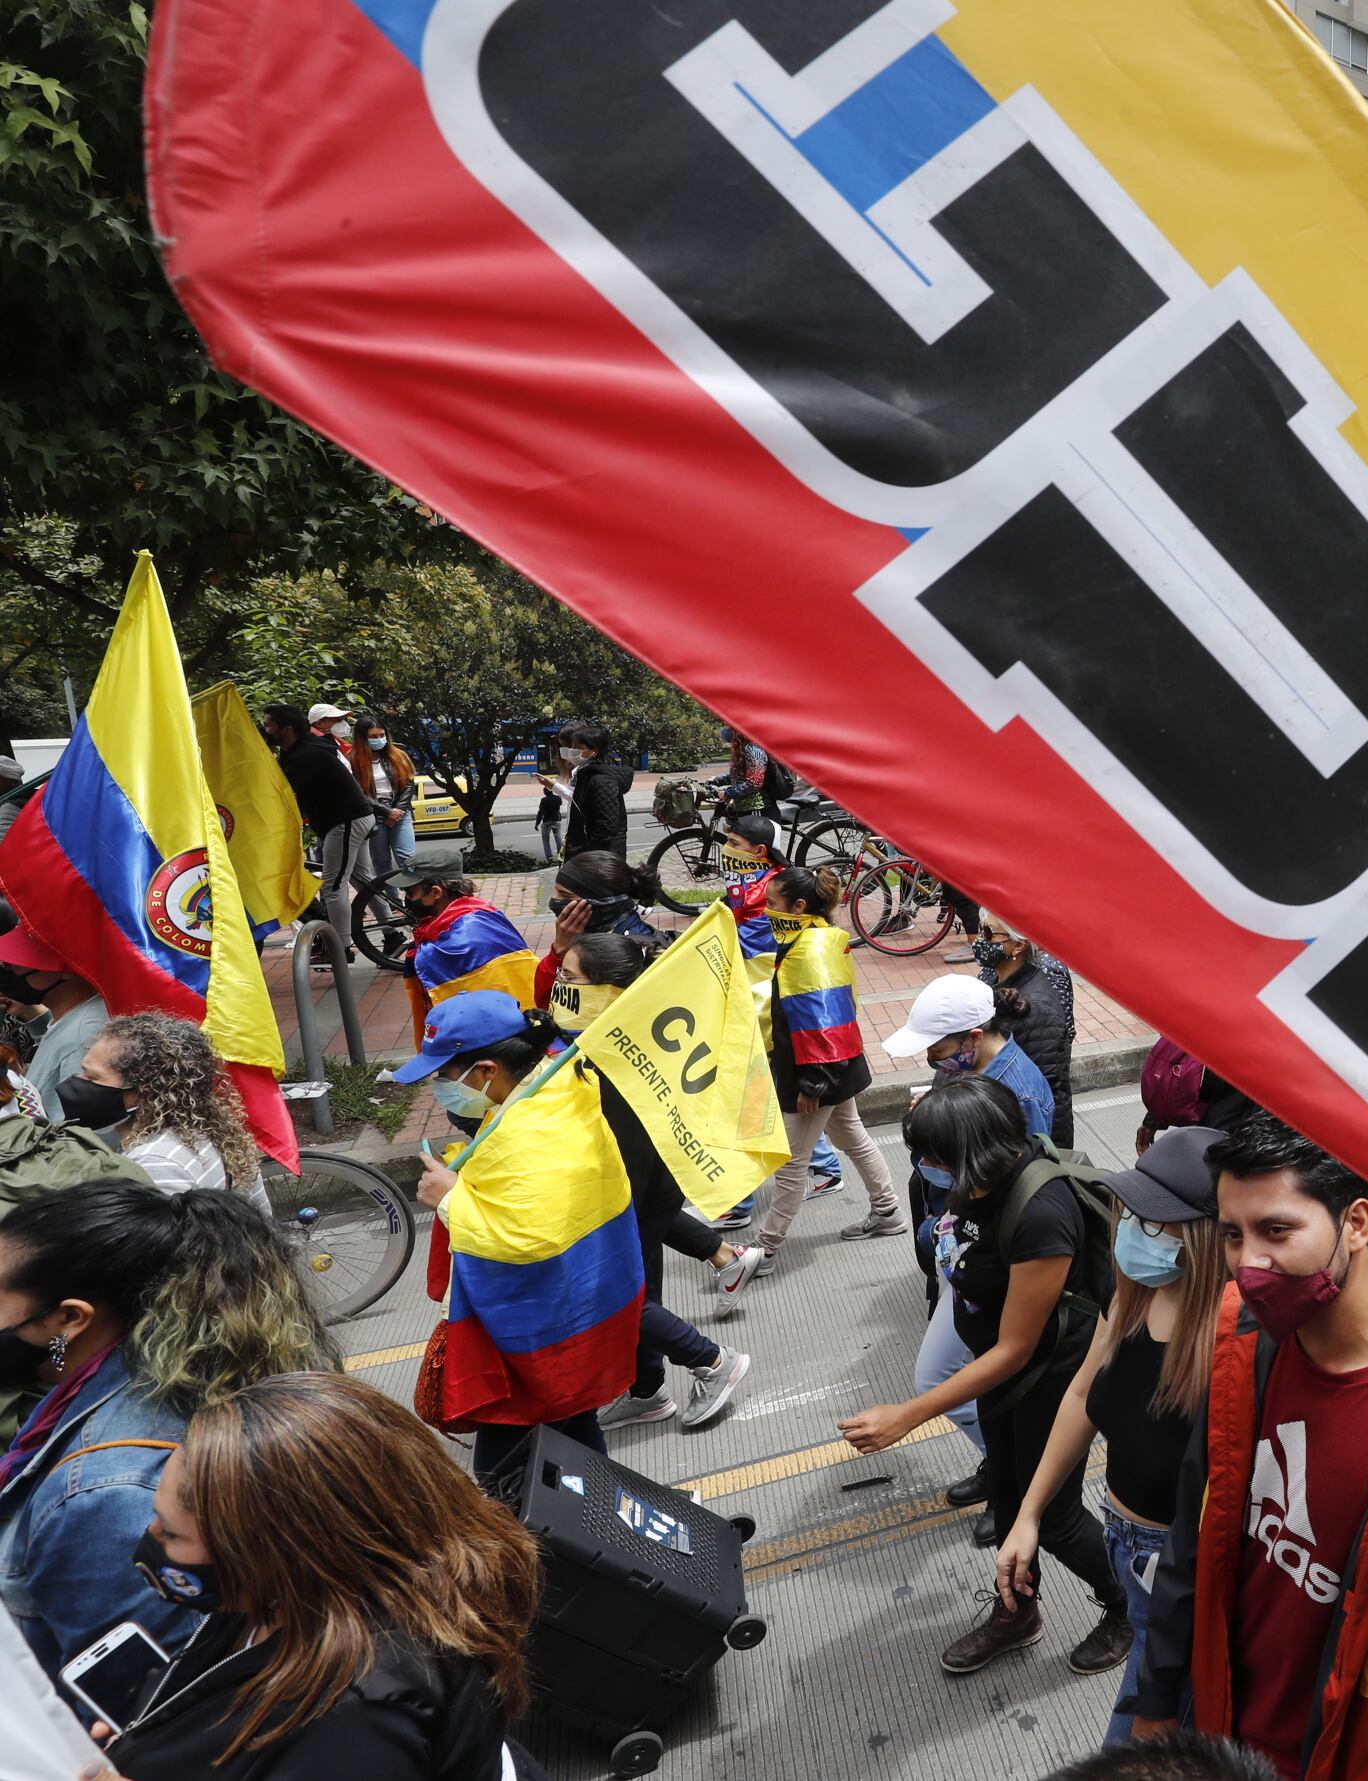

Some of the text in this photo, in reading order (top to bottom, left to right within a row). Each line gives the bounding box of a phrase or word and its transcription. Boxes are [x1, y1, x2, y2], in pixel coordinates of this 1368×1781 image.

[151, 890, 206, 952] DE COLOM
[711, 943, 731, 980] SINDICAT
[651, 1006, 718, 1094] CU
[605, 1027, 671, 1103] PRESENTE
[666, 1105, 726, 1184] PRESENTE
